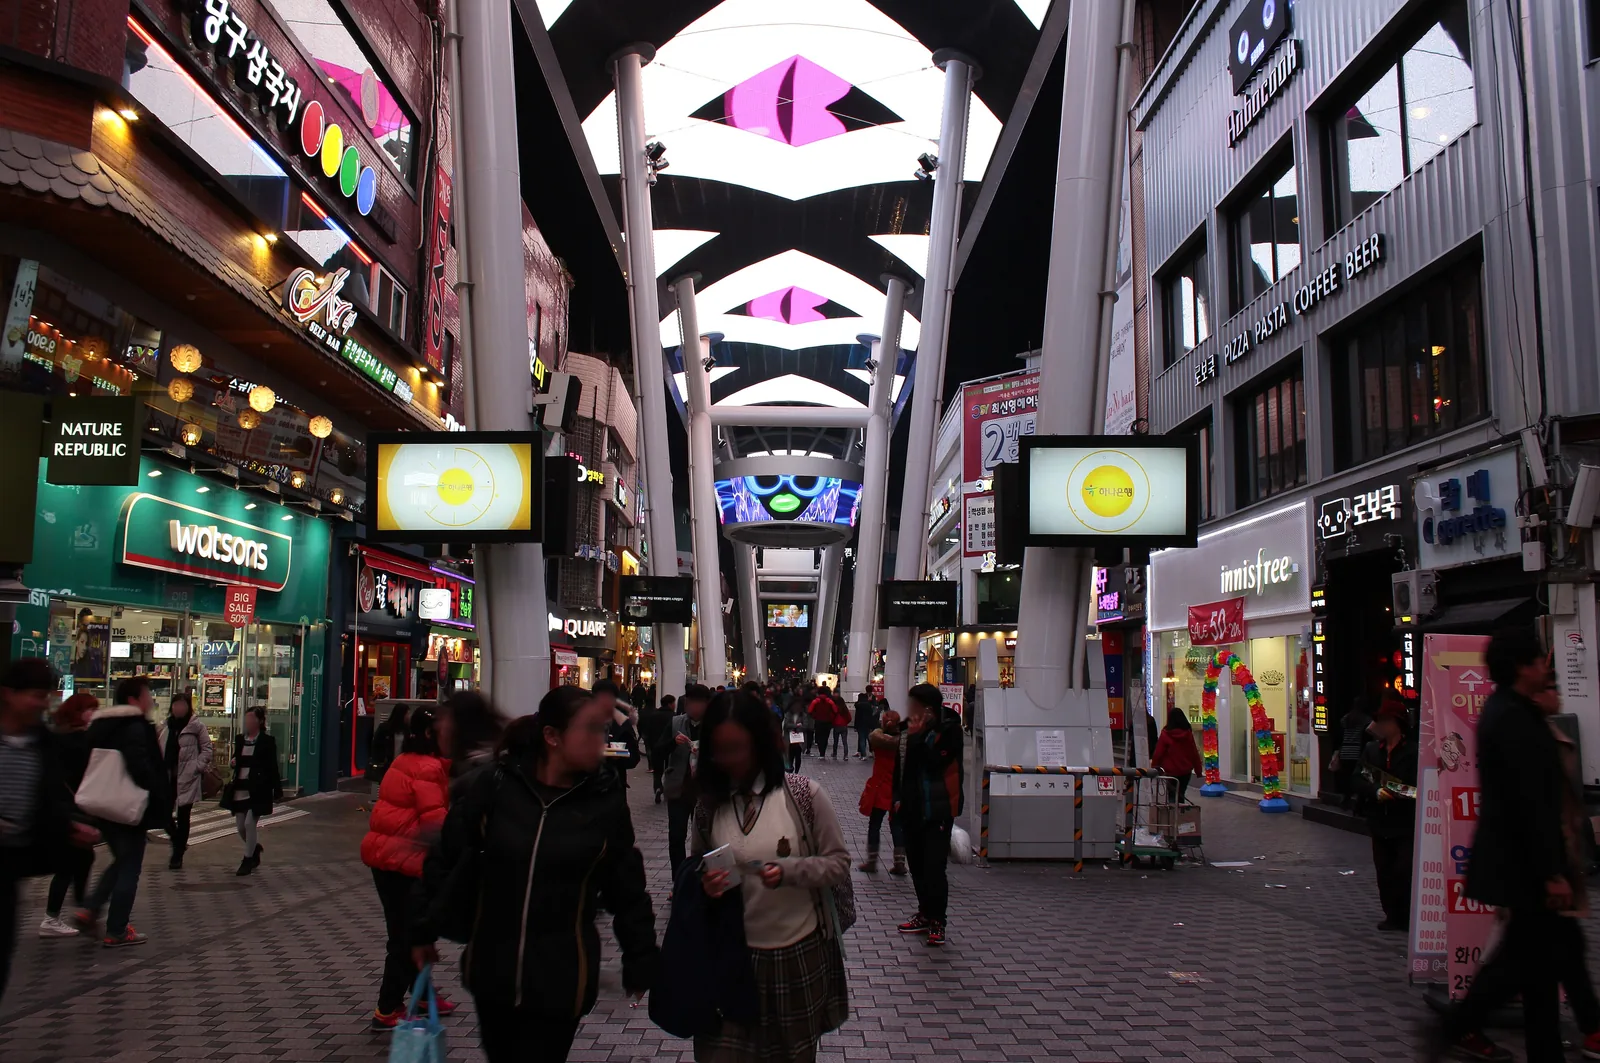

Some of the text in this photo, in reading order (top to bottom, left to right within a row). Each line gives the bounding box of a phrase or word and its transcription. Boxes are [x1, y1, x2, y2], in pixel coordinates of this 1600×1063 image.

[1194, 233, 1381, 387] 로보쿡 PIZZA PASTA COFFEE BEER
[308, 321, 341, 352] SELF BAR
[61, 422, 122, 437] NATURE
[53, 443, 127, 457] REPUBLIC
[1099, 487, 1133, 498] 하나은행
[1353, 484, 1396, 526] 로보쿡
[1423, 505, 1506, 546] Cgarette
[170, 519, 268, 571] watsons
[1220, 548, 1292, 595] innisfree
[233, 592, 250, 603] BIG
[228, 603, 253, 614] SALE
[229, 614, 248, 624] 50%
[1109, 666, 1115, 674] 3
